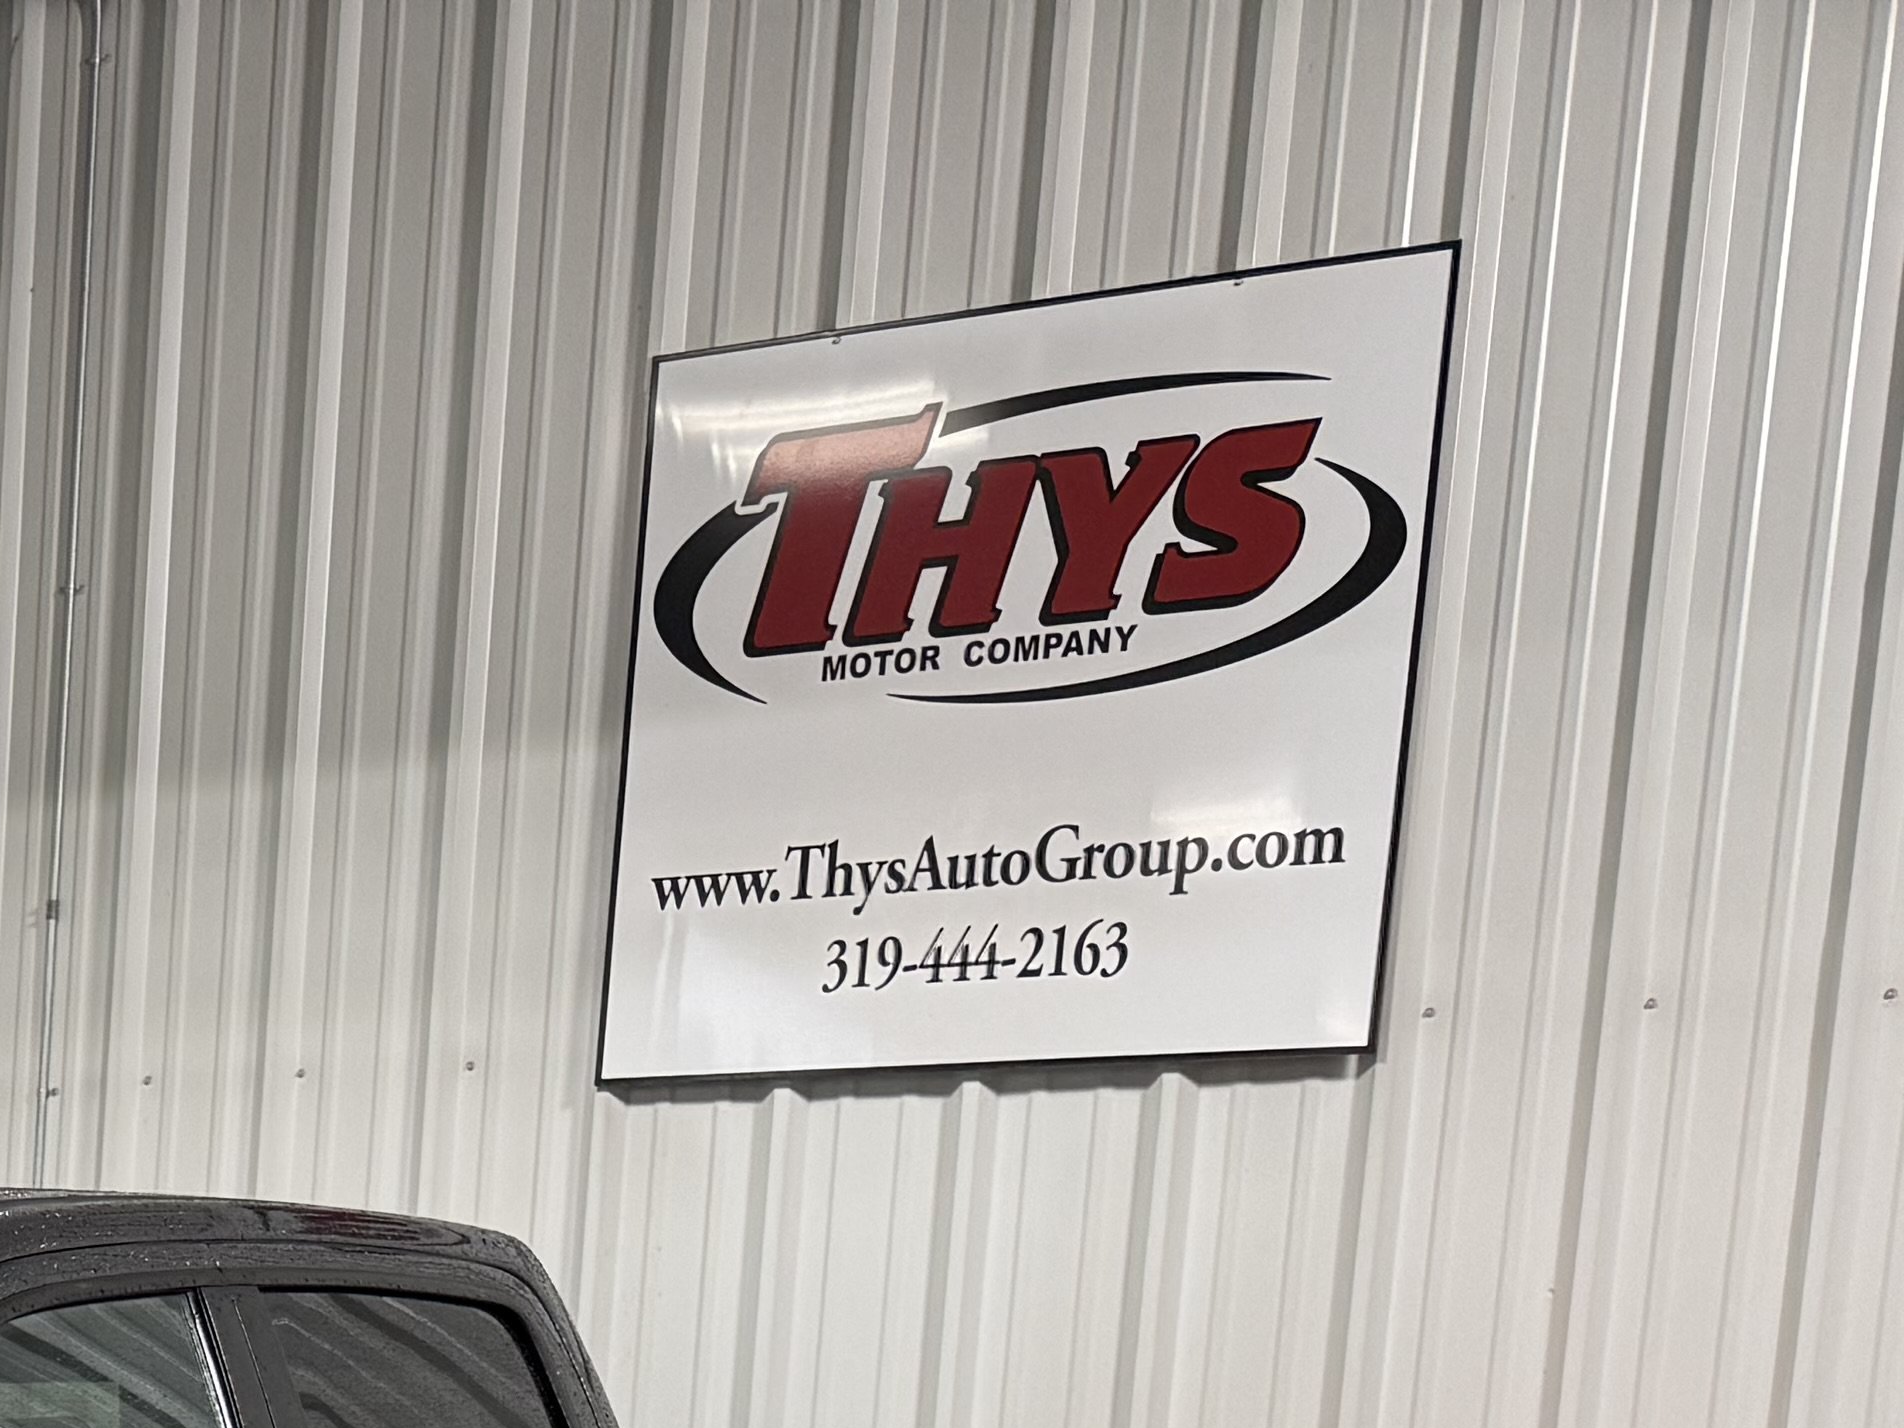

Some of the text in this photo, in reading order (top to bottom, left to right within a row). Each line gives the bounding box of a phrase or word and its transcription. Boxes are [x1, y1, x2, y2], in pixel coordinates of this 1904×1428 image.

[738, 401, 1323, 658] THYS
[820, 623, 1139, 682] MOTOR COMPANY
[651, 818, 1346, 916] www.ThysAutoGroup.com
[821, 919, 1130, 994] 319-444-2163
